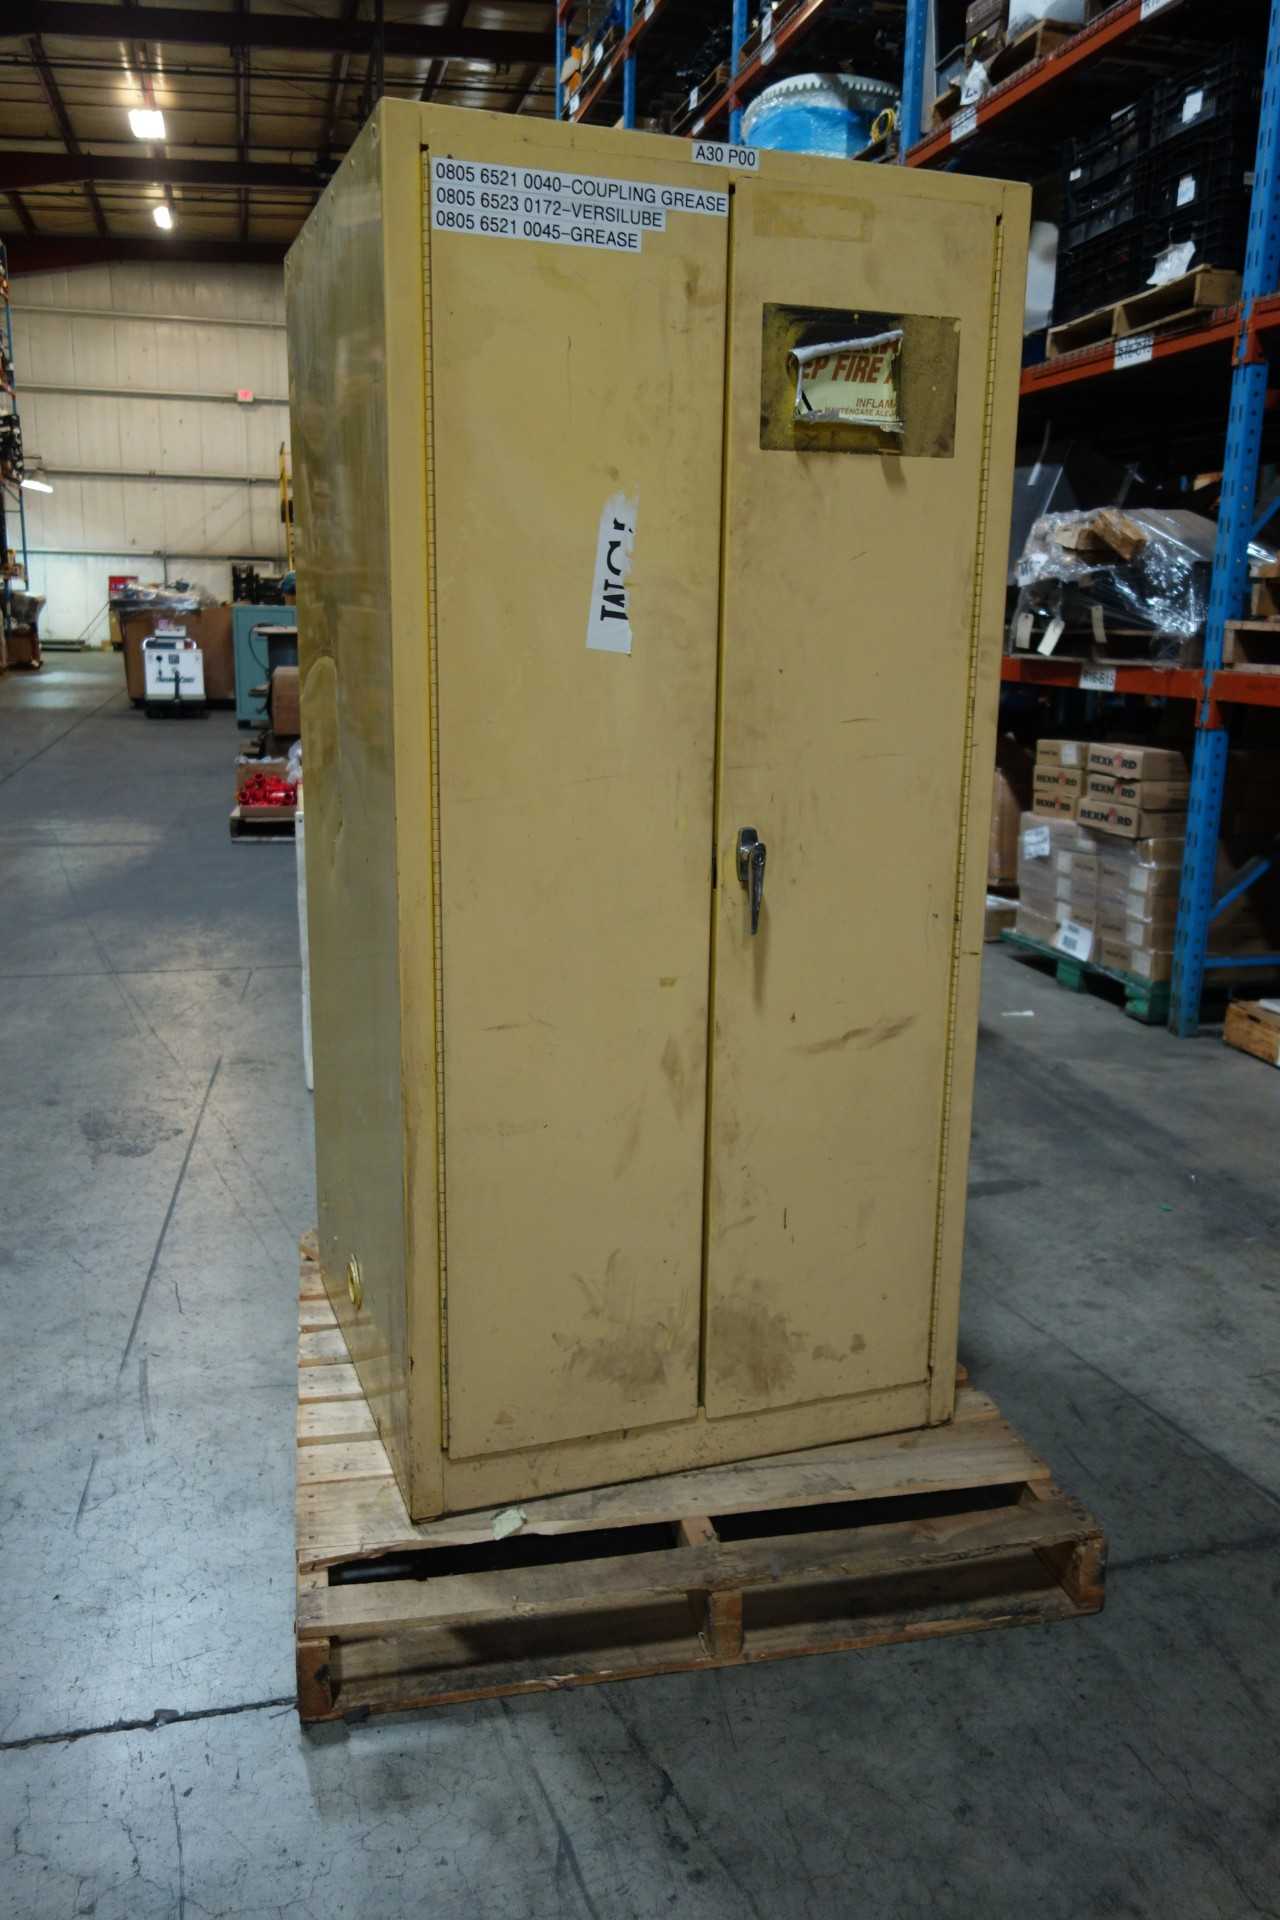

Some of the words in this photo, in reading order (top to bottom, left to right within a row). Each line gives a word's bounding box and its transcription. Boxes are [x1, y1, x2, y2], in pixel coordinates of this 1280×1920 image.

[695, 145, 724, 163] A30
[728, 148, 756, 167] P00
[436, 162, 475, 182] 0805
[480, 168, 517, 187] 6521
[523, 173, 656, 204] 0040-COUPLING
[661, 189, 727, 213] GREASE
[436, 187, 475, 207] 0805
[480, 192, 519, 211] 6523
[524, 197, 663, 228] 0172-VERSILUBE
[436, 210, 475, 230] 0805
[480, 216, 517, 234] 6521
[523, 221, 638, 248] 0045-GREASE
[831, 354, 884, 384] FIRE
